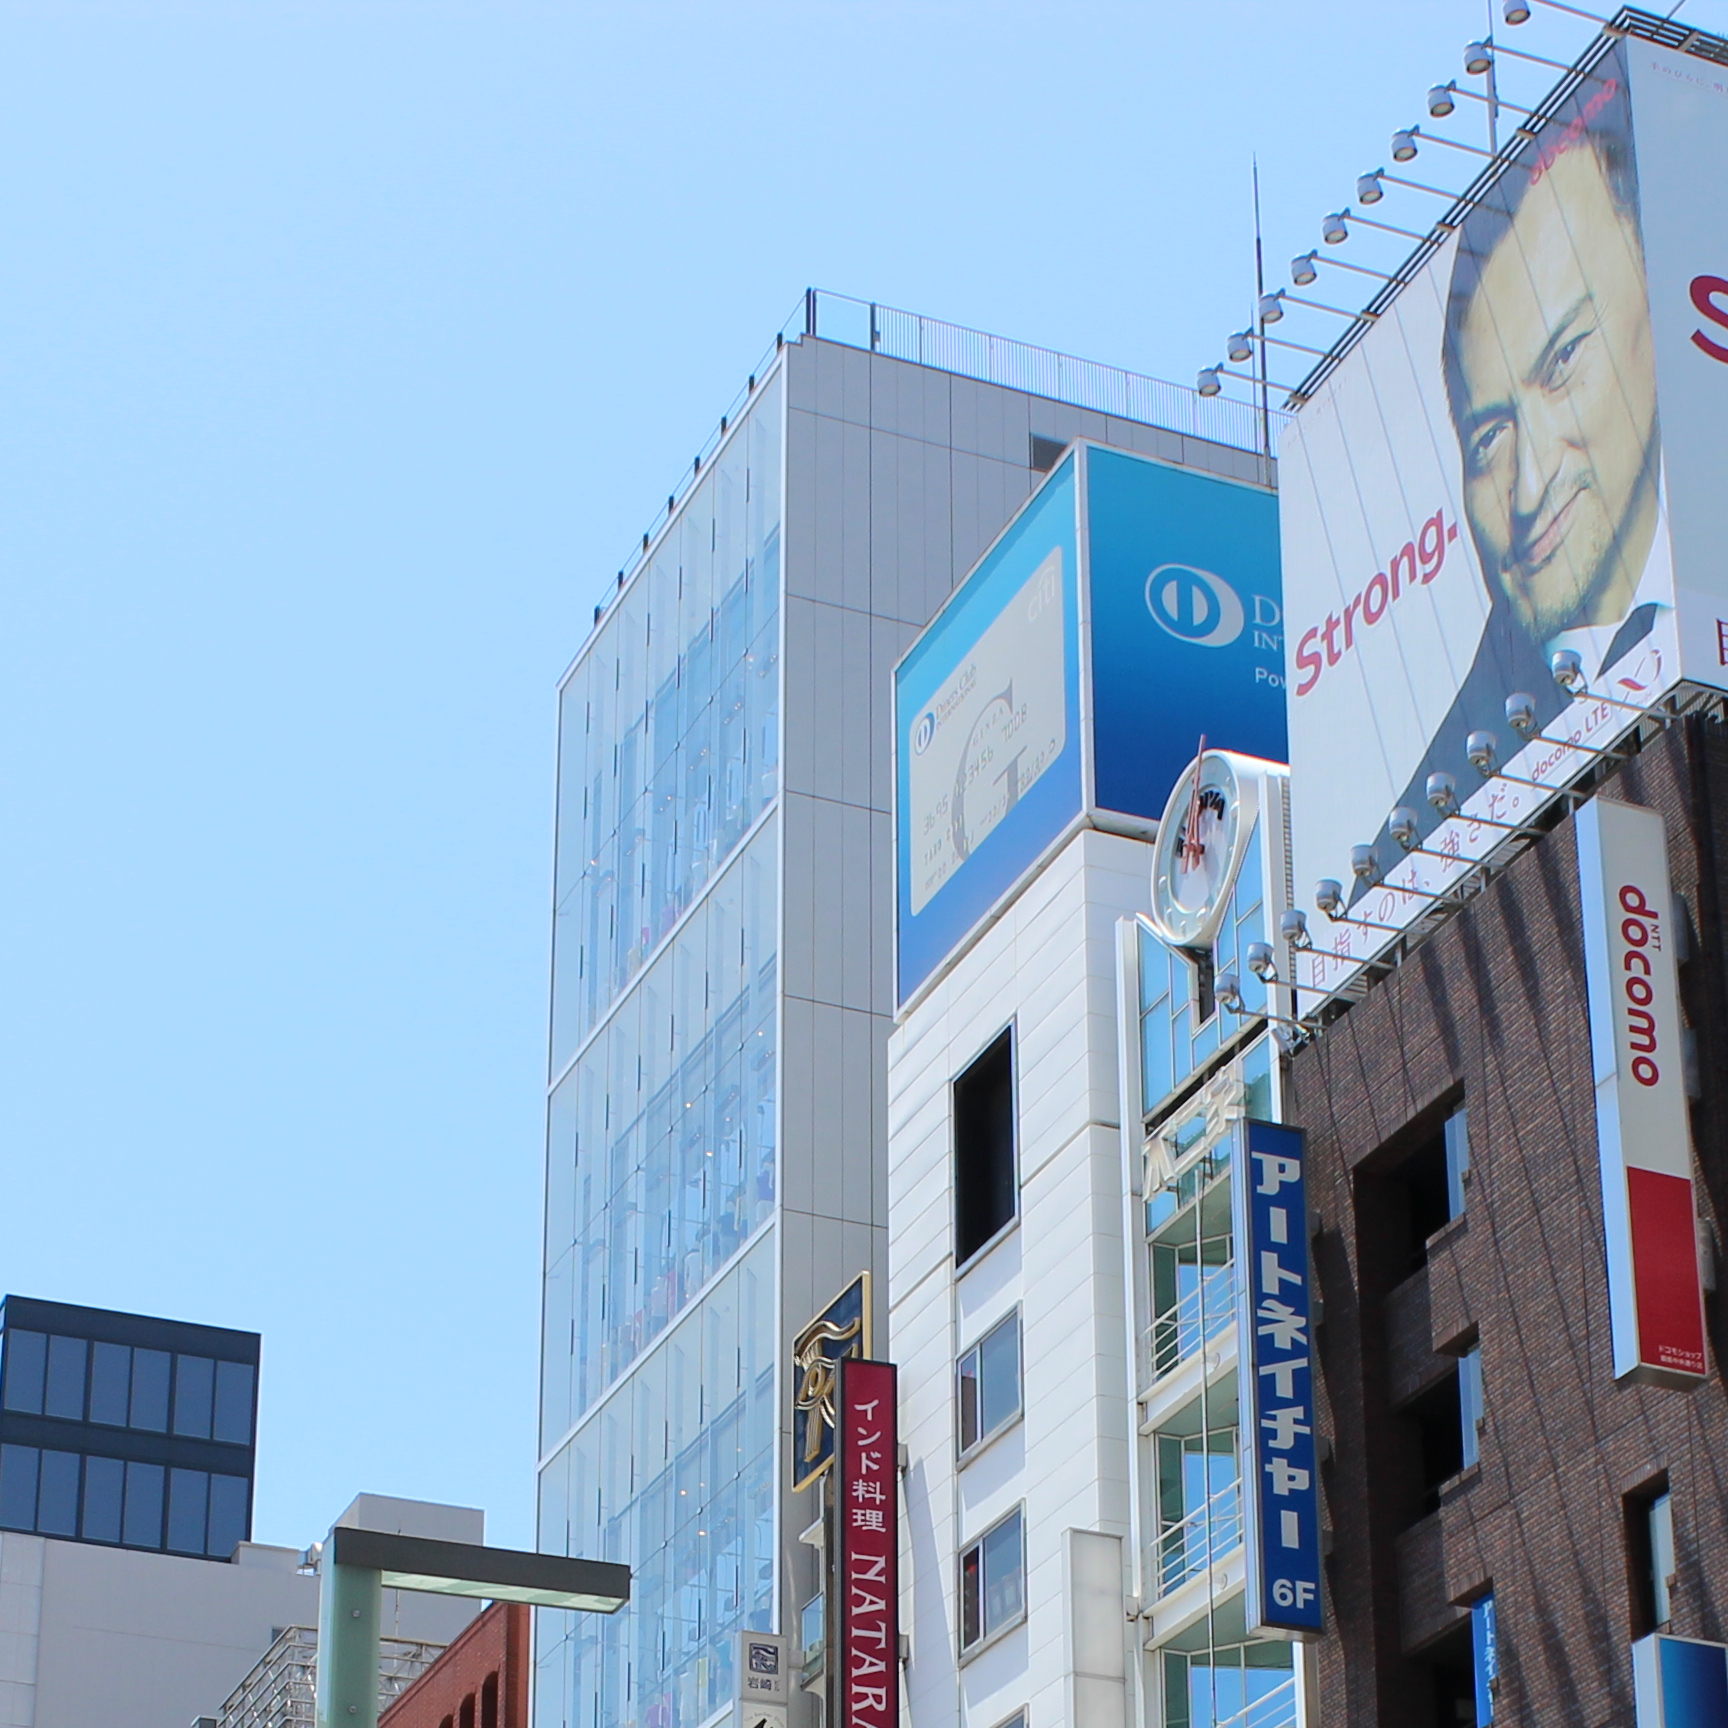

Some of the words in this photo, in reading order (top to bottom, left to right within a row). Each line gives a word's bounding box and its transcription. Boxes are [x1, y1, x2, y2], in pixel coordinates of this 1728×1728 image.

[1027, 565, 1056, 624] citi
[1294, 507, 1458, 698] Strong.
[1530, 729, 1582, 783] docomo
[1583, 703, 1610, 736] LTE
[1647, 920, 1662, 952] NTT
[1618, 883, 1660, 1088] docomo
[1250, 1149, 1312, 1550] アートネイチャー
[1658, 1344, 1703, 1360] ドコモショップ
[852, 1398, 887, 1534] インド料理
[1271, 1577, 1315, 1609] 6F
